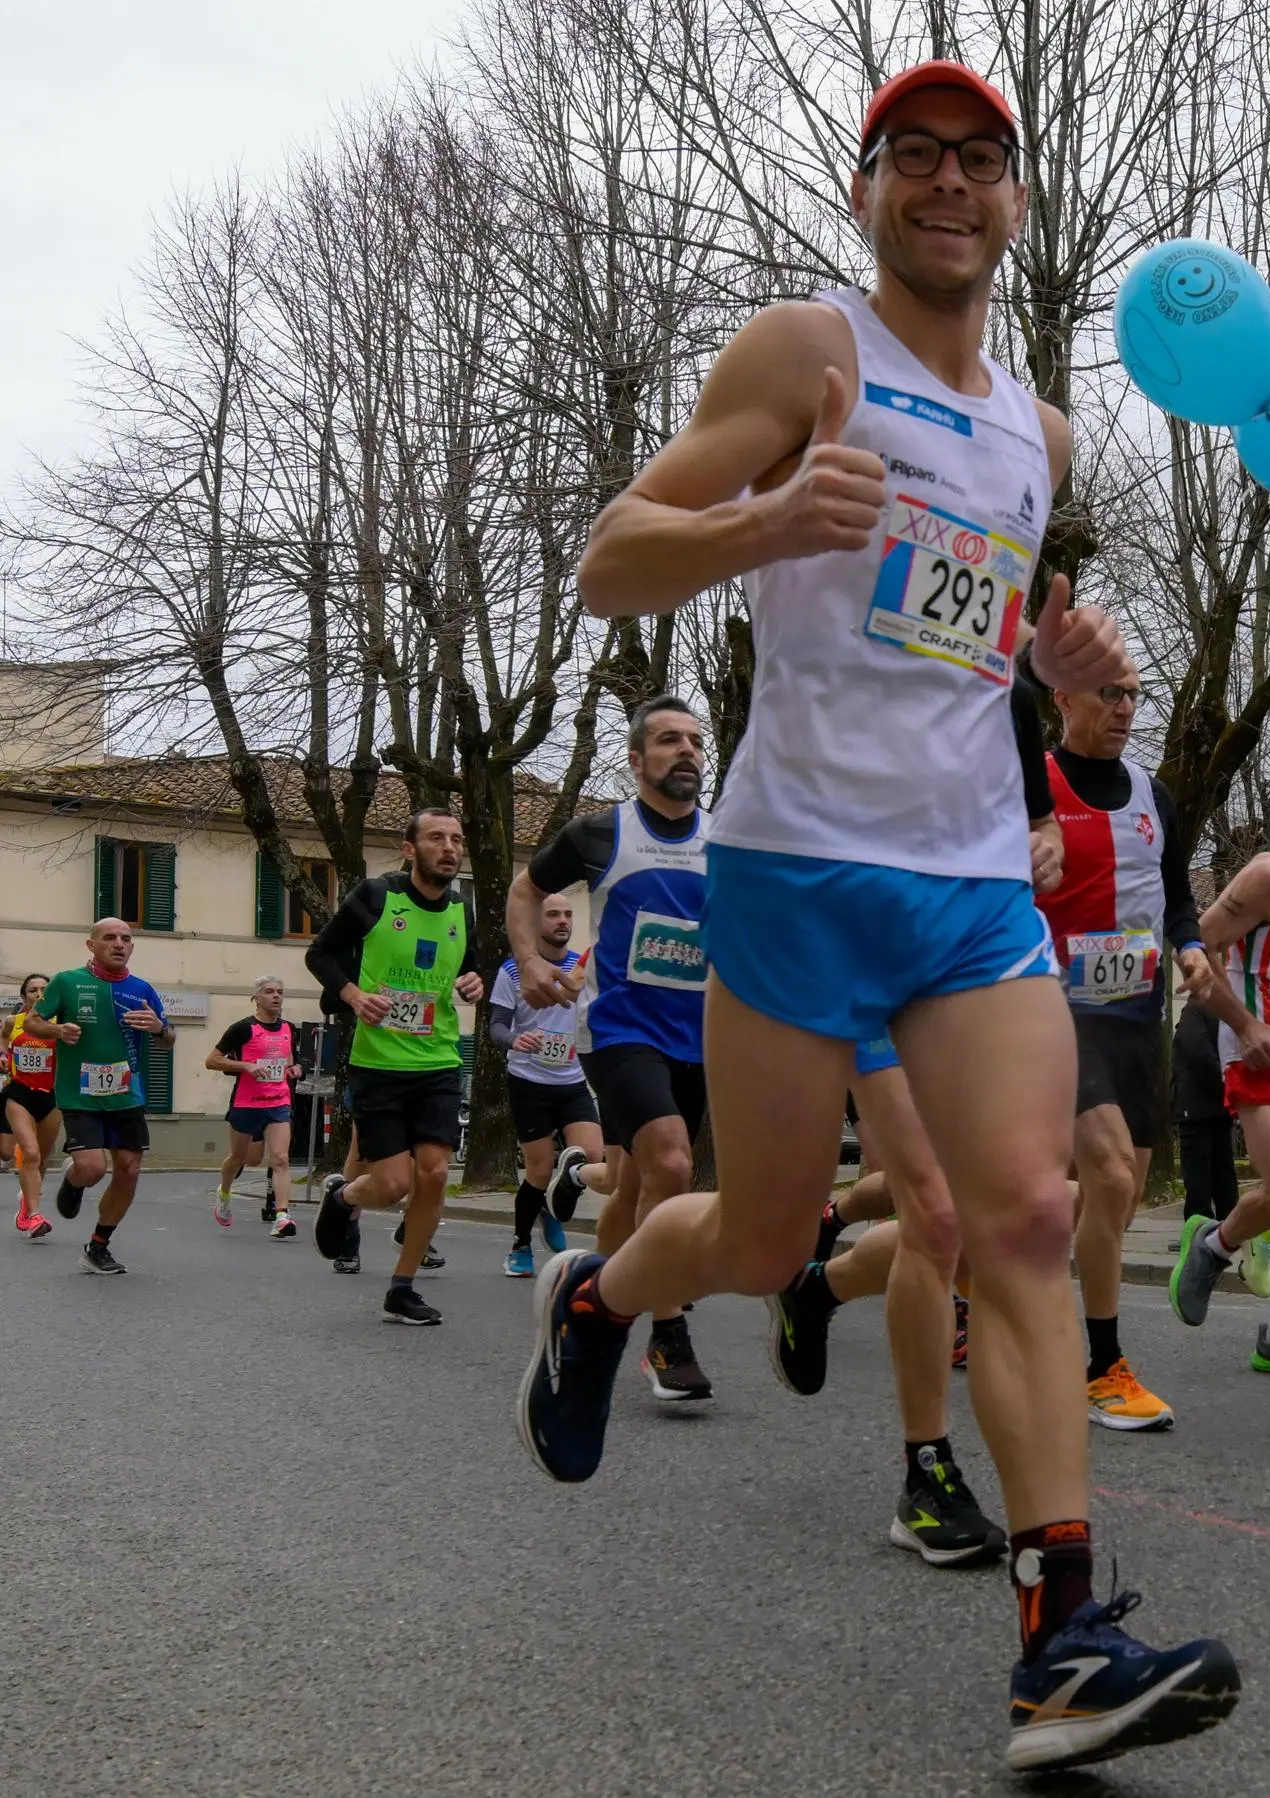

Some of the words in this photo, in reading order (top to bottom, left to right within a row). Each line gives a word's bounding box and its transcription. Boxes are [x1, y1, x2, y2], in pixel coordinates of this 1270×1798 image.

[898, 509, 952, 550] XIX
[921, 558, 995, 637] 293
[918, 629, 973, 655] CRAFT
[1075, 938, 1101, 952] XIX
[1093, 953, 1135, 984] 619
[390, 1002, 418, 1023] 529
[544, 1041, 567, 1058] 359
[22, 1054, 41, 1067] 388
[98, 1074, 114, 1088] 19
